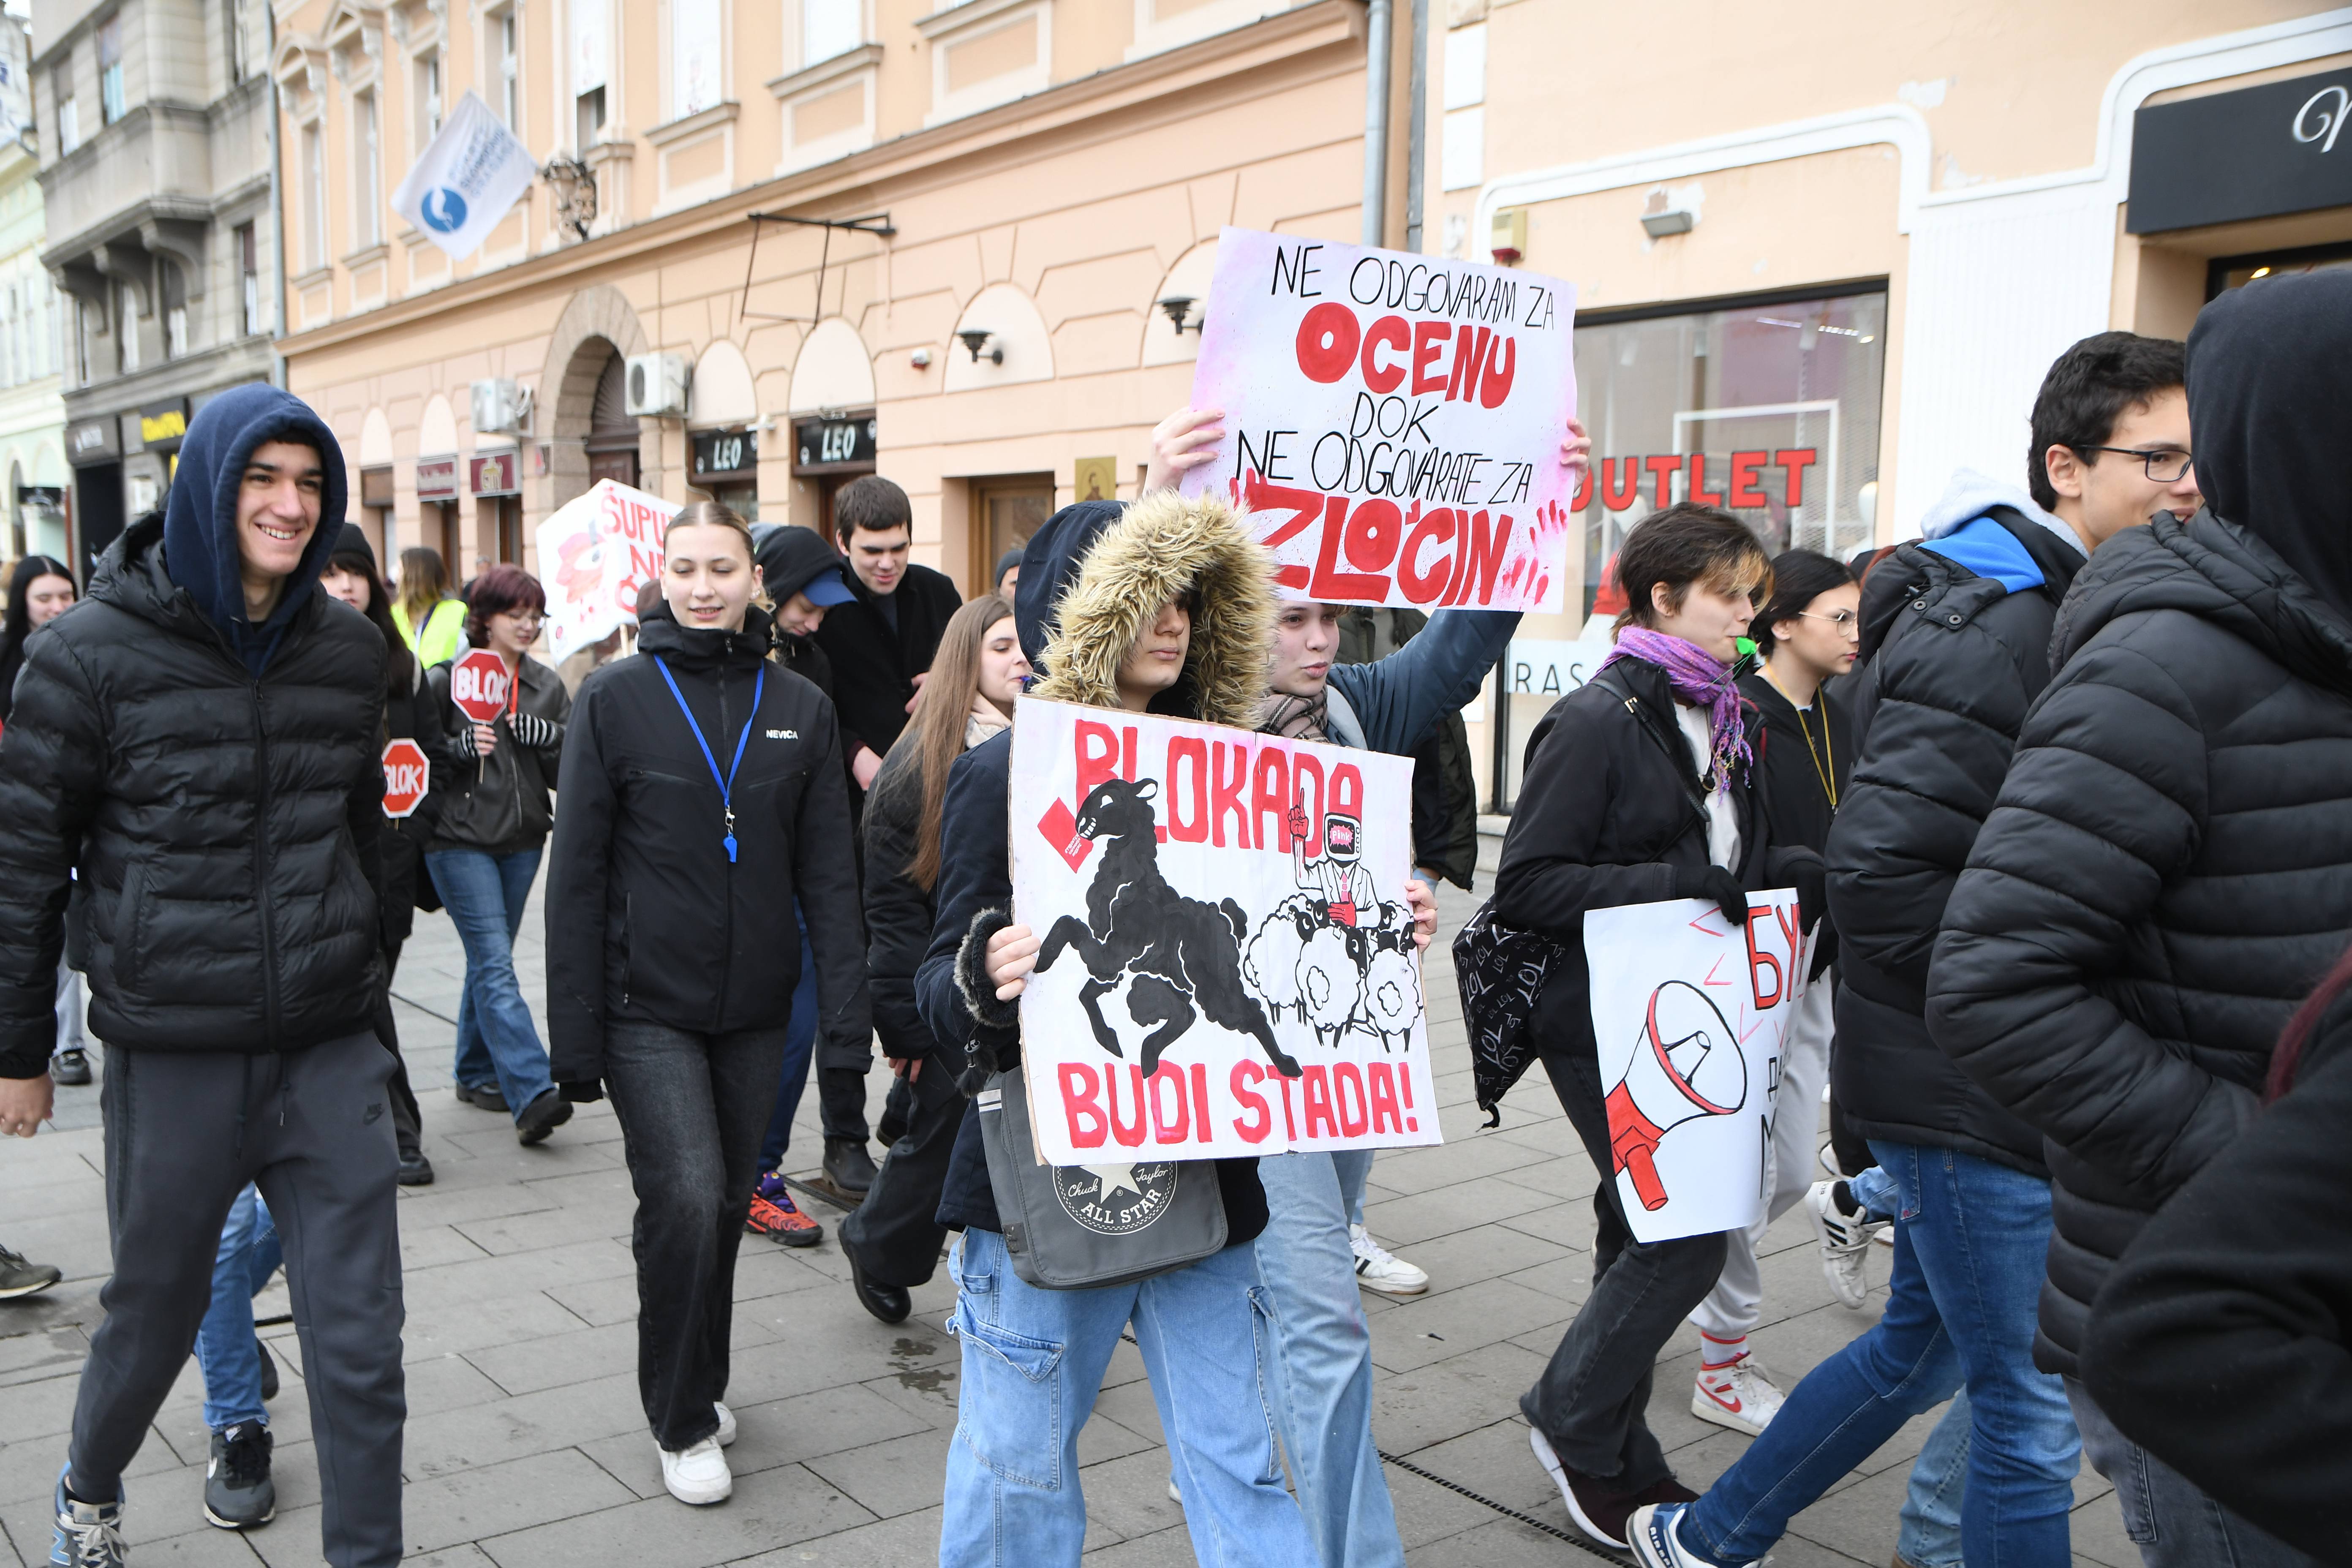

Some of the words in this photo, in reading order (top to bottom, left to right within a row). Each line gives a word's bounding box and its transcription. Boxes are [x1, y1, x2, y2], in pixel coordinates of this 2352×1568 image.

[1271, 244, 1324, 298] NE
[1350, 257, 1516, 324] ODGOVARAM
[1524, 286, 1554, 331] ZA
[1296, 302, 1516, 409] OCENU
[1350, 392, 1439, 444] DOK
[713, 437, 742, 471] LEO
[821, 424, 856, 462] LEO
[1236, 430, 1298, 481] NE
[1312, 431, 1493, 504] ODGOVARATE
[1489, 462, 1533, 504] ZA
[602, 487, 674, 548] ŠUPU
[456, 666, 508, 705] BLOK
[766, 730, 798, 739] NEVICA
[1057, 1059, 1213, 1149] BUDI
[1230, 1058, 1419, 1143] STADA!
[1068, 1178, 1098, 1197] Chuck
[1136, 1164, 1168, 1184] Taylor
[1081, 1202, 1114, 1224] ALL
[1120, 1189, 1162, 1223] STAR
